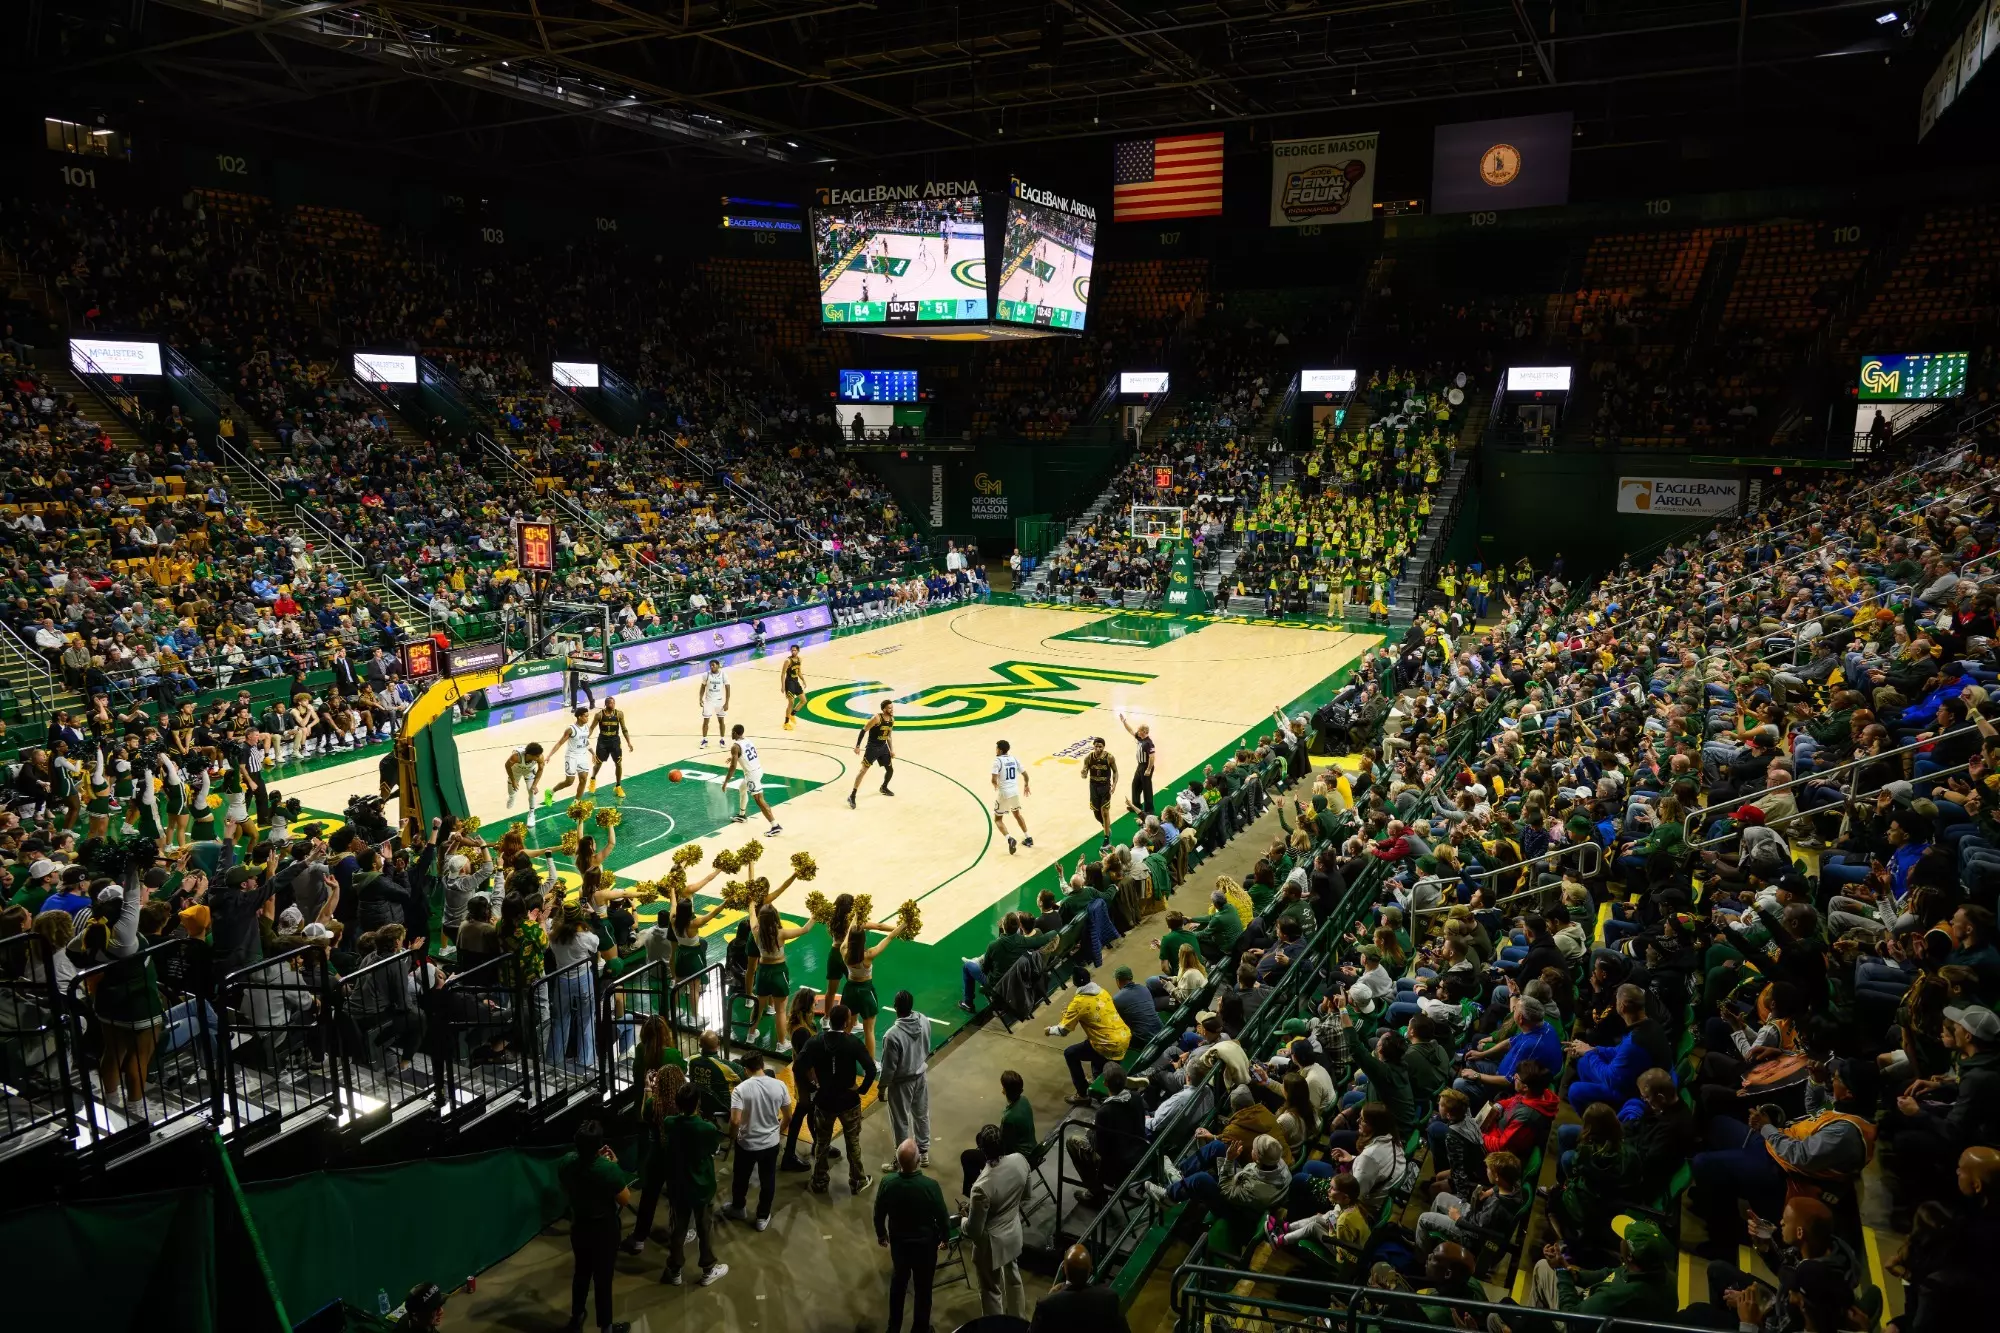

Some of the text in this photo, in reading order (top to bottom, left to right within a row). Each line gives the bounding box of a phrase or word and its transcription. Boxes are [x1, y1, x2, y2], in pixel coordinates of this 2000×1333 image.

[1274, 138, 1375, 157] GEORGE MASON
[216, 154, 247, 174] 102
[60, 166, 95, 188] 101
[1302, 175, 1345, 188] FINAL
[923, 180, 978, 197] ARENA
[1286, 186, 1345, 204] FOUR
[1070, 199, 1096, 220] ARENA
[1645, 199, 1671, 215] 110
[595, 217, 618, 232] 104
[1470, 212, 1497, 226] 109
[481, 227, 505, 244] 103
[753, 231, 777, 244] 105
[1160, 232, 1180, 246] 107
[1831, 226, 1861, 244] 110
[889, 302, 916, 313] 10:45
[935, 302, 948, 314] 51
[1060, 311, 1068, 322] 51
[1861, 361, 1900, 393] GM
[974, 472, 1002, 495] GM
[1157, 475, 1170, 486] 30
[972, 497, 1008, 505] GEORGE
[1655, 495, 1702, 507] ARENA
[972, 505, 1008, 514] MASON
[525, 527, 549, 541] 10:45
[526, 542, 546, 565] 30
[409, 645, 431, 658] 10:45
[745, 745, 758, 761] 23
[1005, 767, 1016, 780] 10
[694, 1066, 712, 1078] CSC
